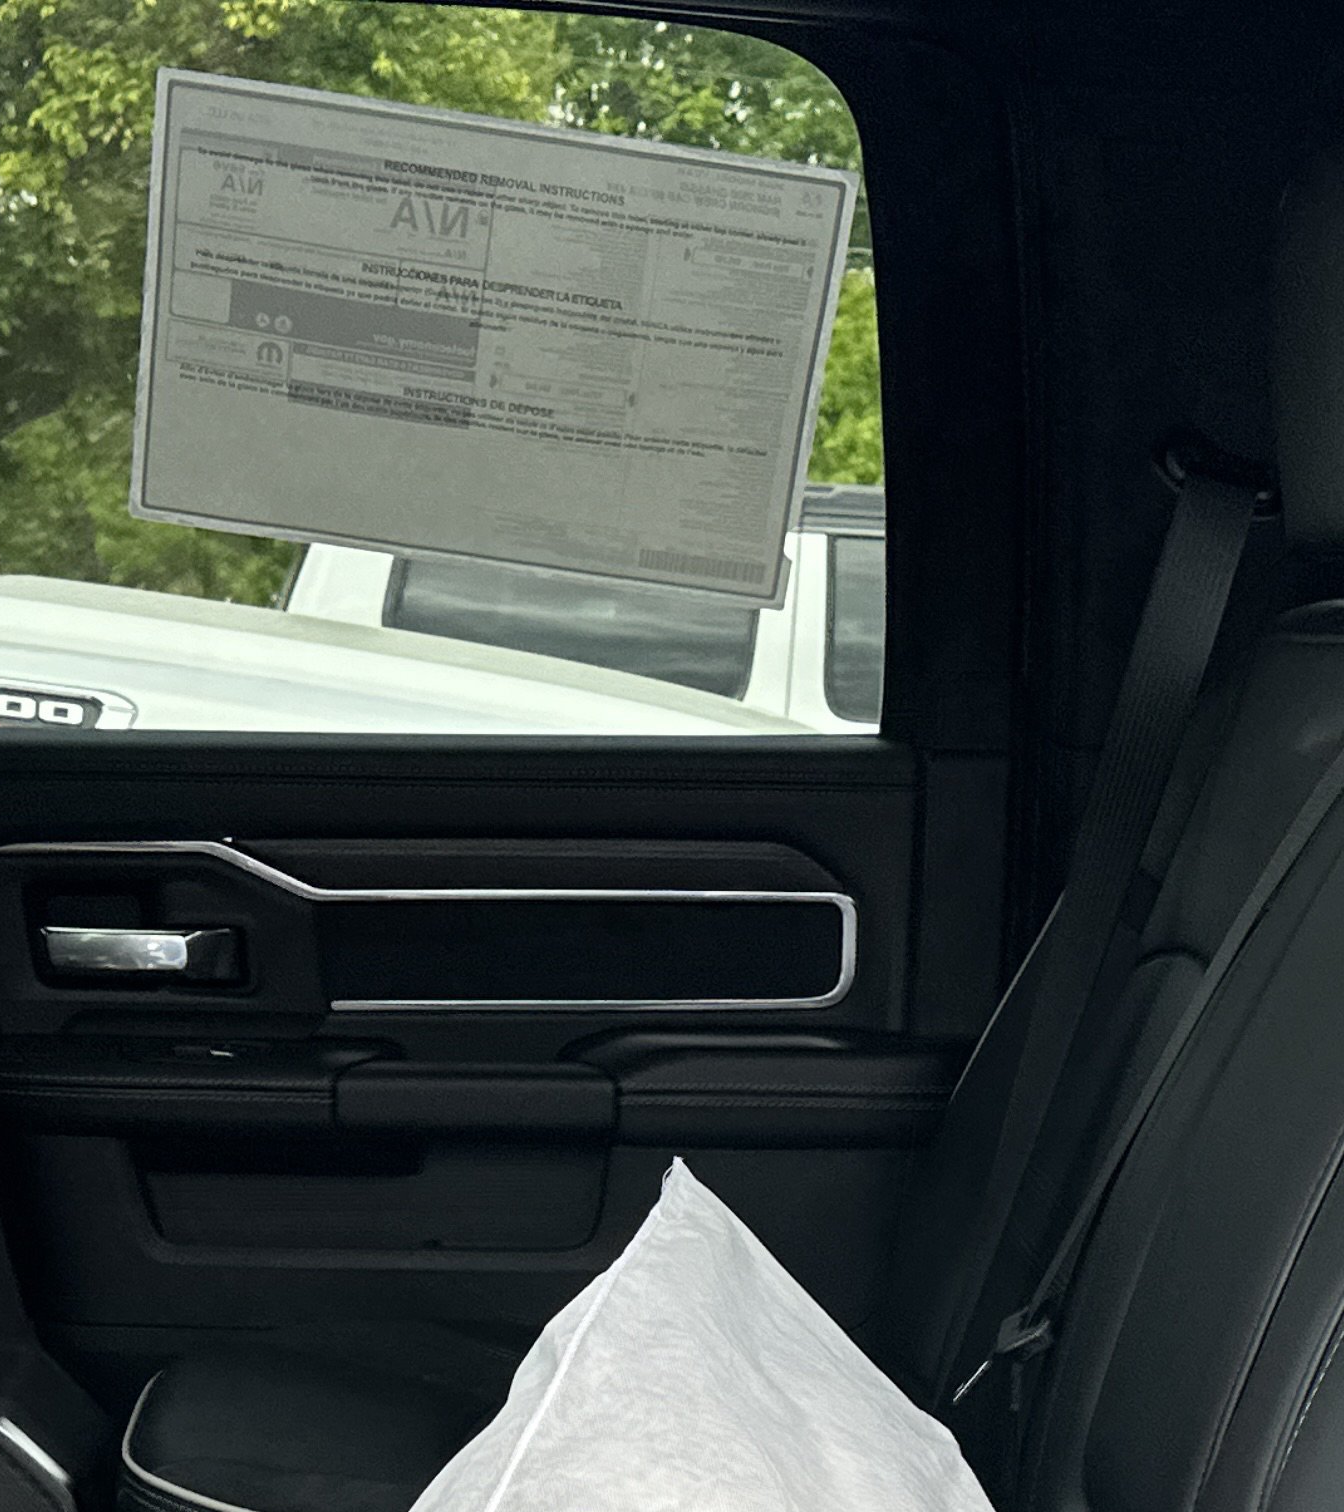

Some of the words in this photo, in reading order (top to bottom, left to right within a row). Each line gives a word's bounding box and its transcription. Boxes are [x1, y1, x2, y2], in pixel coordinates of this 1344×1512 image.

[383, 159, 478, 183] RECOMMENDED
[479, 173, 537, 192] REMOVAL
[538, 182, 625, 206] INSTRUCTIONS
[449, 274, 479, 289] PARA
[482, 279, 555, 300] DESPRENDER
[555, 290, 570, 302] LA
[570, 292, 624, 311] ETIQUETA
[402, 386, 487, 408] INSTRUCTIONS
[489, 399, 506, 411] DE
